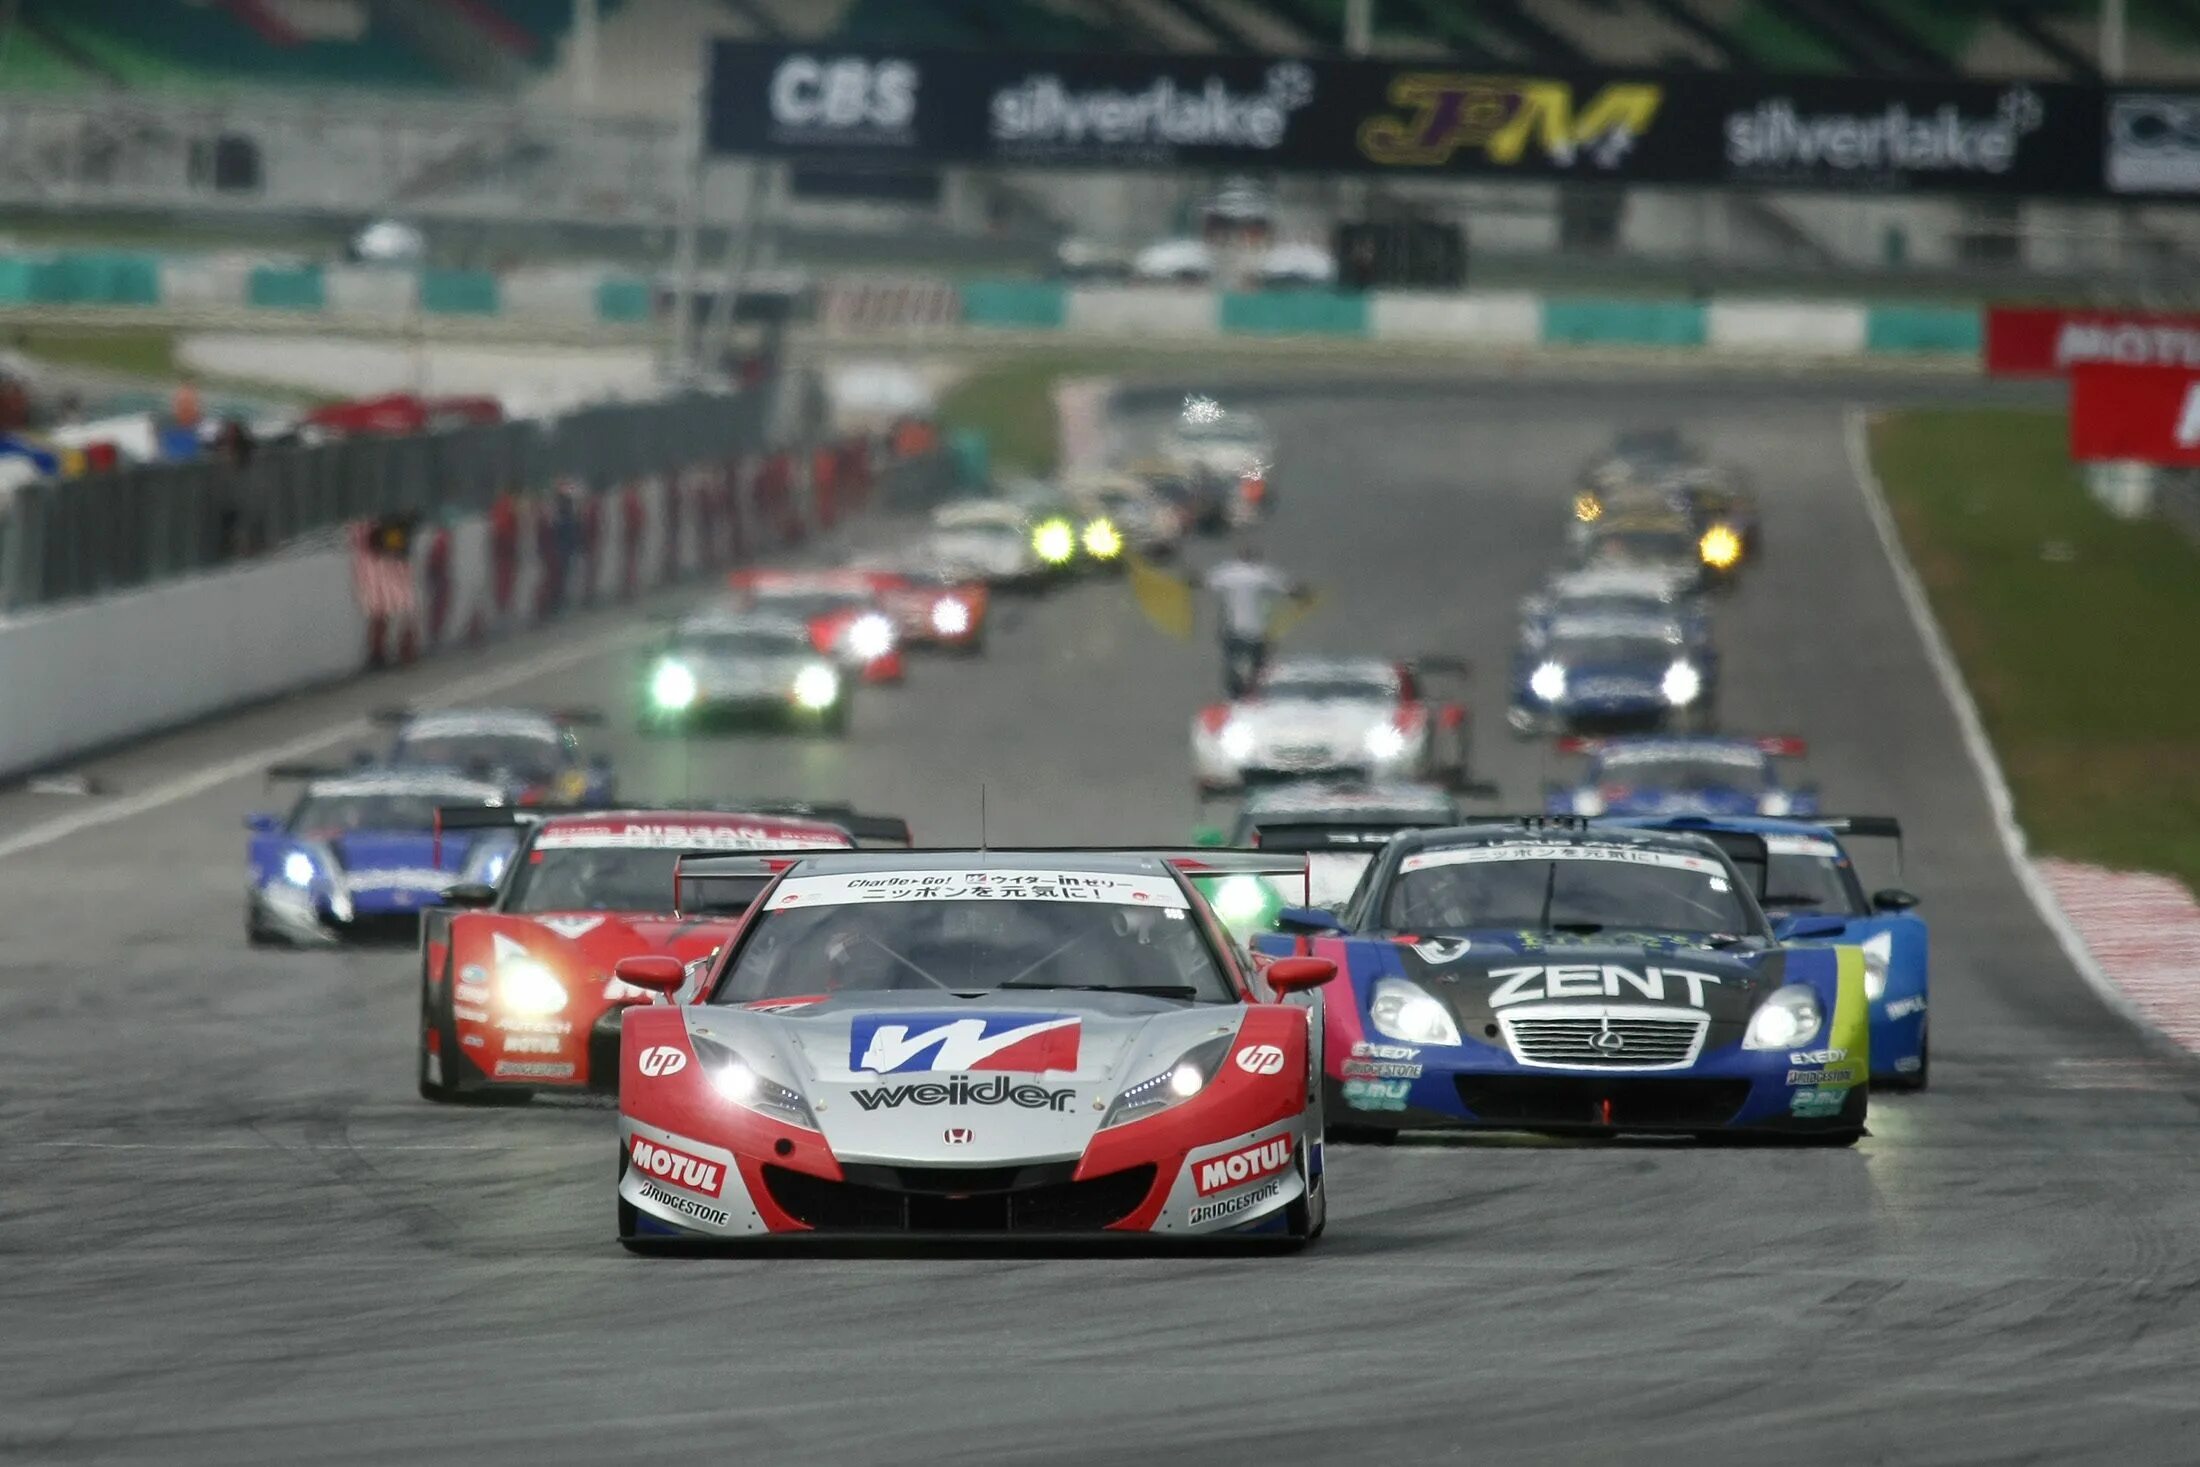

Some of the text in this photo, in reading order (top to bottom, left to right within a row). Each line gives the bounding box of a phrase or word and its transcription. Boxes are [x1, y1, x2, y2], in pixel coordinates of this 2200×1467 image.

[770, 57, 917, 124] CBS
[990, 75, 1286, 149] silverlake
[1724, 98, 2015, 172] silverlake
[1488, 965, 1721, 1008] ZENT
[643, 1047, 683, 1077] hp
[1242, 1045, 1282, 1074] hp
[1351, 1042, 1421, 1060] EXEDY
[1790, 1049, 1848, 1065] EXEDY
[633, 1141, 717, 1192] MOTUL
[1202, 1139, 1290, 1191] MOTUL
[639, 1182, 728, 1226] BRIDGESTONE
[1191, 1181, 1280, 1224] BRIDGESTONE
